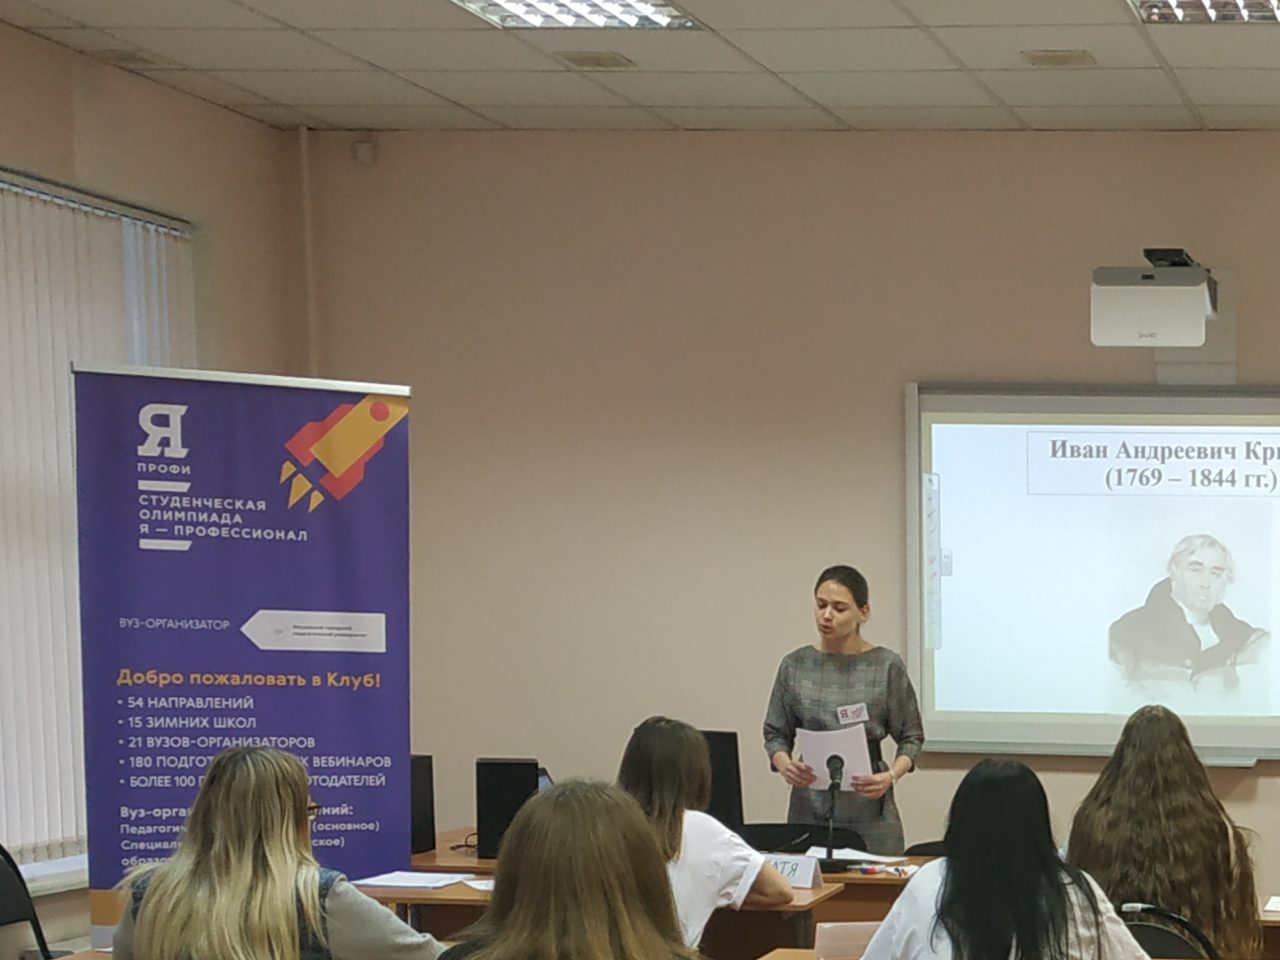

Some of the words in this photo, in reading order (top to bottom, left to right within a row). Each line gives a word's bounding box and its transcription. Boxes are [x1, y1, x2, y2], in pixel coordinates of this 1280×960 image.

[137, 403, 189, 458] Я
[1050, 439, 1108, 459] Иван
[1115, 440, 1237, 465] Андреевич
[137, 462, 191, 475] ПРОФИ
[1105, 467, 1163, 491] (1769
[1189, 468, 1237, 488] 1844
[1244, 470, 1278, 492] гг.)
[138, 494, 267, 511] СТУДЕНЧЕСКАЯ
[138, 509, 243, 525] ОЛИМПИАДА
[139, 523, 149, 534] Я
[174, 525, 308, 541] ПРОФЕССИОНАЛ
[119, 617, 231, 630] ВУЗ-ОРГАНИЗАТОР
[116, 668, 184, 687] Добро
[190, 672, 306, 687] пожаловать
[312, 676, 321, 687] в
[327, 671, 381, 690] Клуб!
[127, 697, 144, 708] 54
[148, 695, 254, 709] НАПРАВЛЕНИЙ
[128, 717, 143, 728] 15
[146, 717, 210, 729] ЗИМНИХ
[213, 717, 257, 729] ШКОЛ
[128, 737, 143, 748] 21
[146, 736, 316, 749] ВУЗОВ-ОРГАНИЗАТОРОВ
[129, 756, 152, 768] 180
[156, 756, 216, 769] ПОДГОТ
[313, 756, 392, 768] ВЕБИНАРОВ
[130, 775, 172, 787] БОЛЕЕ
[174, 775, 195, 787] 100
[307, 773, 386, 788] ТОДАТЕЛЕЙ
[120, 806, 192, 821] Вуз-орга
[120, 824, 187, 835] Педагоги
[120, 840, 182, 851] Специал
